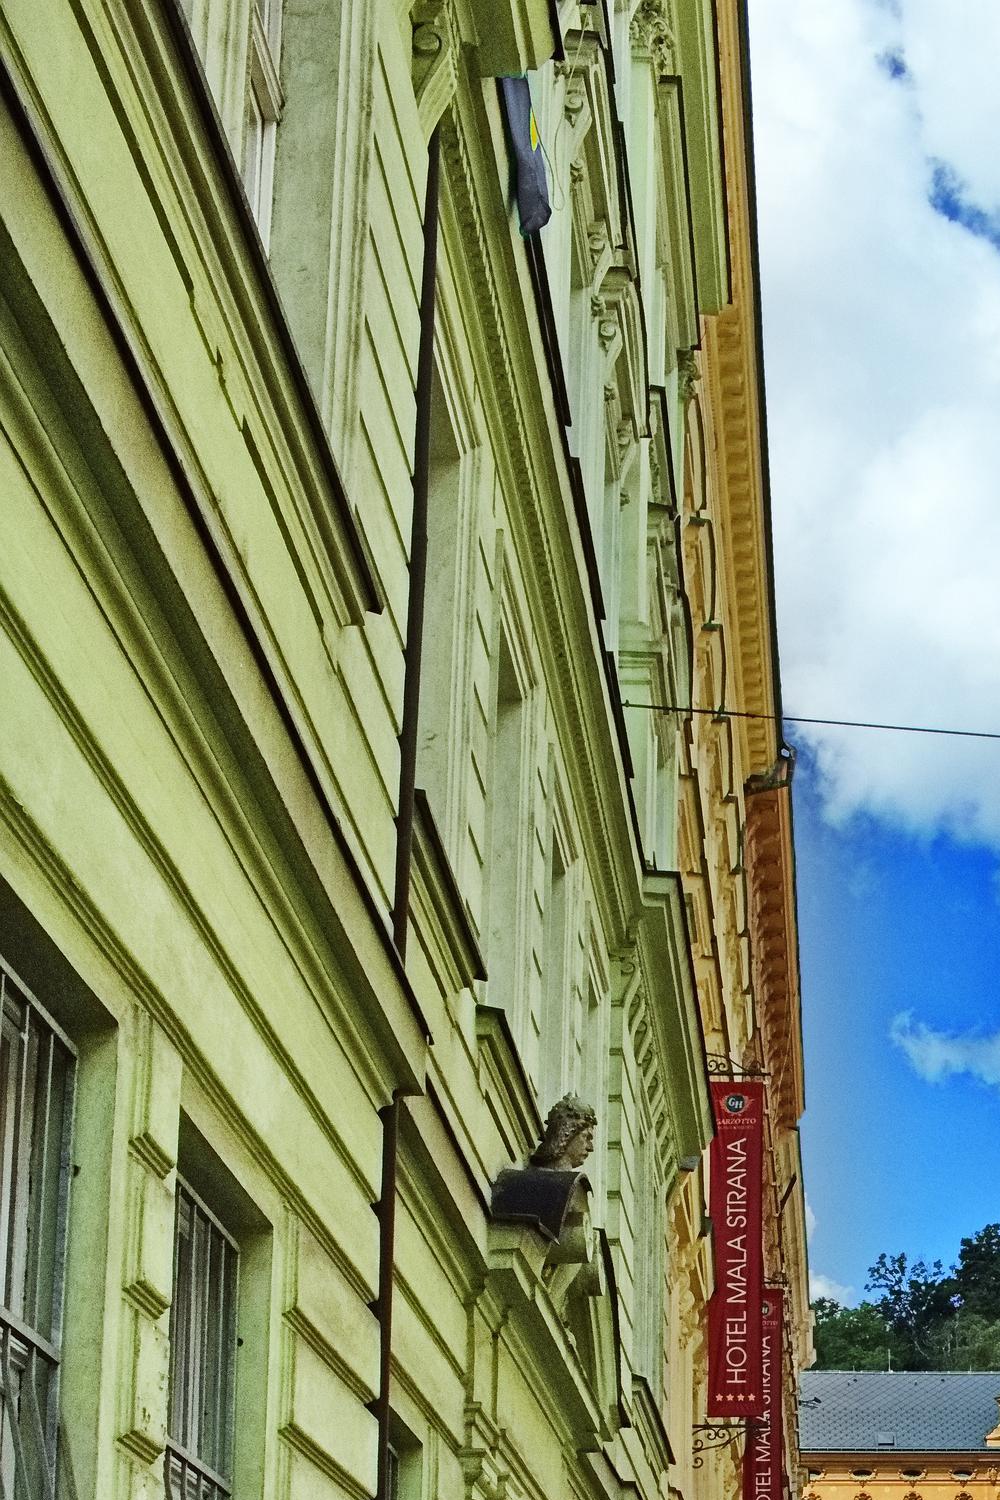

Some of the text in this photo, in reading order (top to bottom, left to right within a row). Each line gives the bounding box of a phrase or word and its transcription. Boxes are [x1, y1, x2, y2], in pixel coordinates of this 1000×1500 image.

[726, 1137, 747, 1228] STRANA
[726, 1234, 747, 1303] MALA
[726, 1311, 747, 1384] HOTEL
